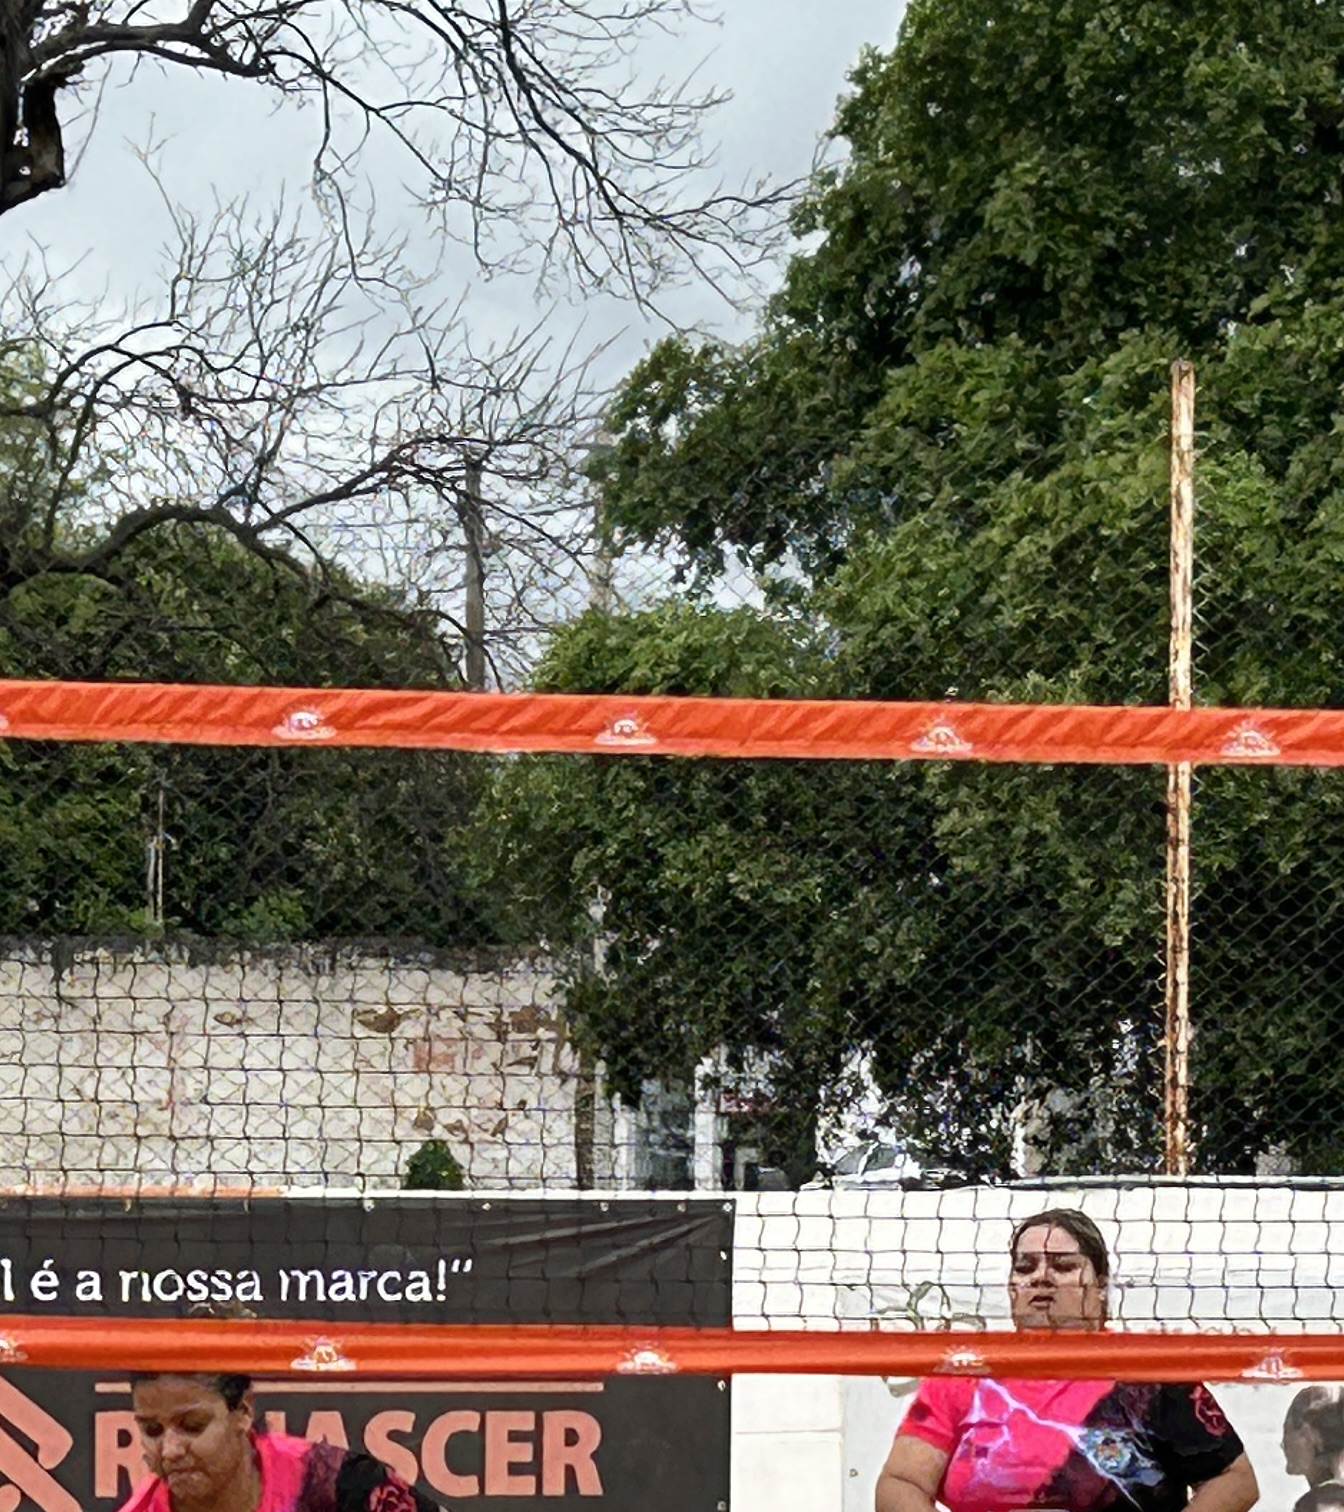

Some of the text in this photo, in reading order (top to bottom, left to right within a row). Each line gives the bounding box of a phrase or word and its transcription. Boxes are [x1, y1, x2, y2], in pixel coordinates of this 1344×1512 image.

[30, 1258, 58, 1302] é
[75, 1269, 103, 1302] a
[119, 1268, 263, 1303] nossa
